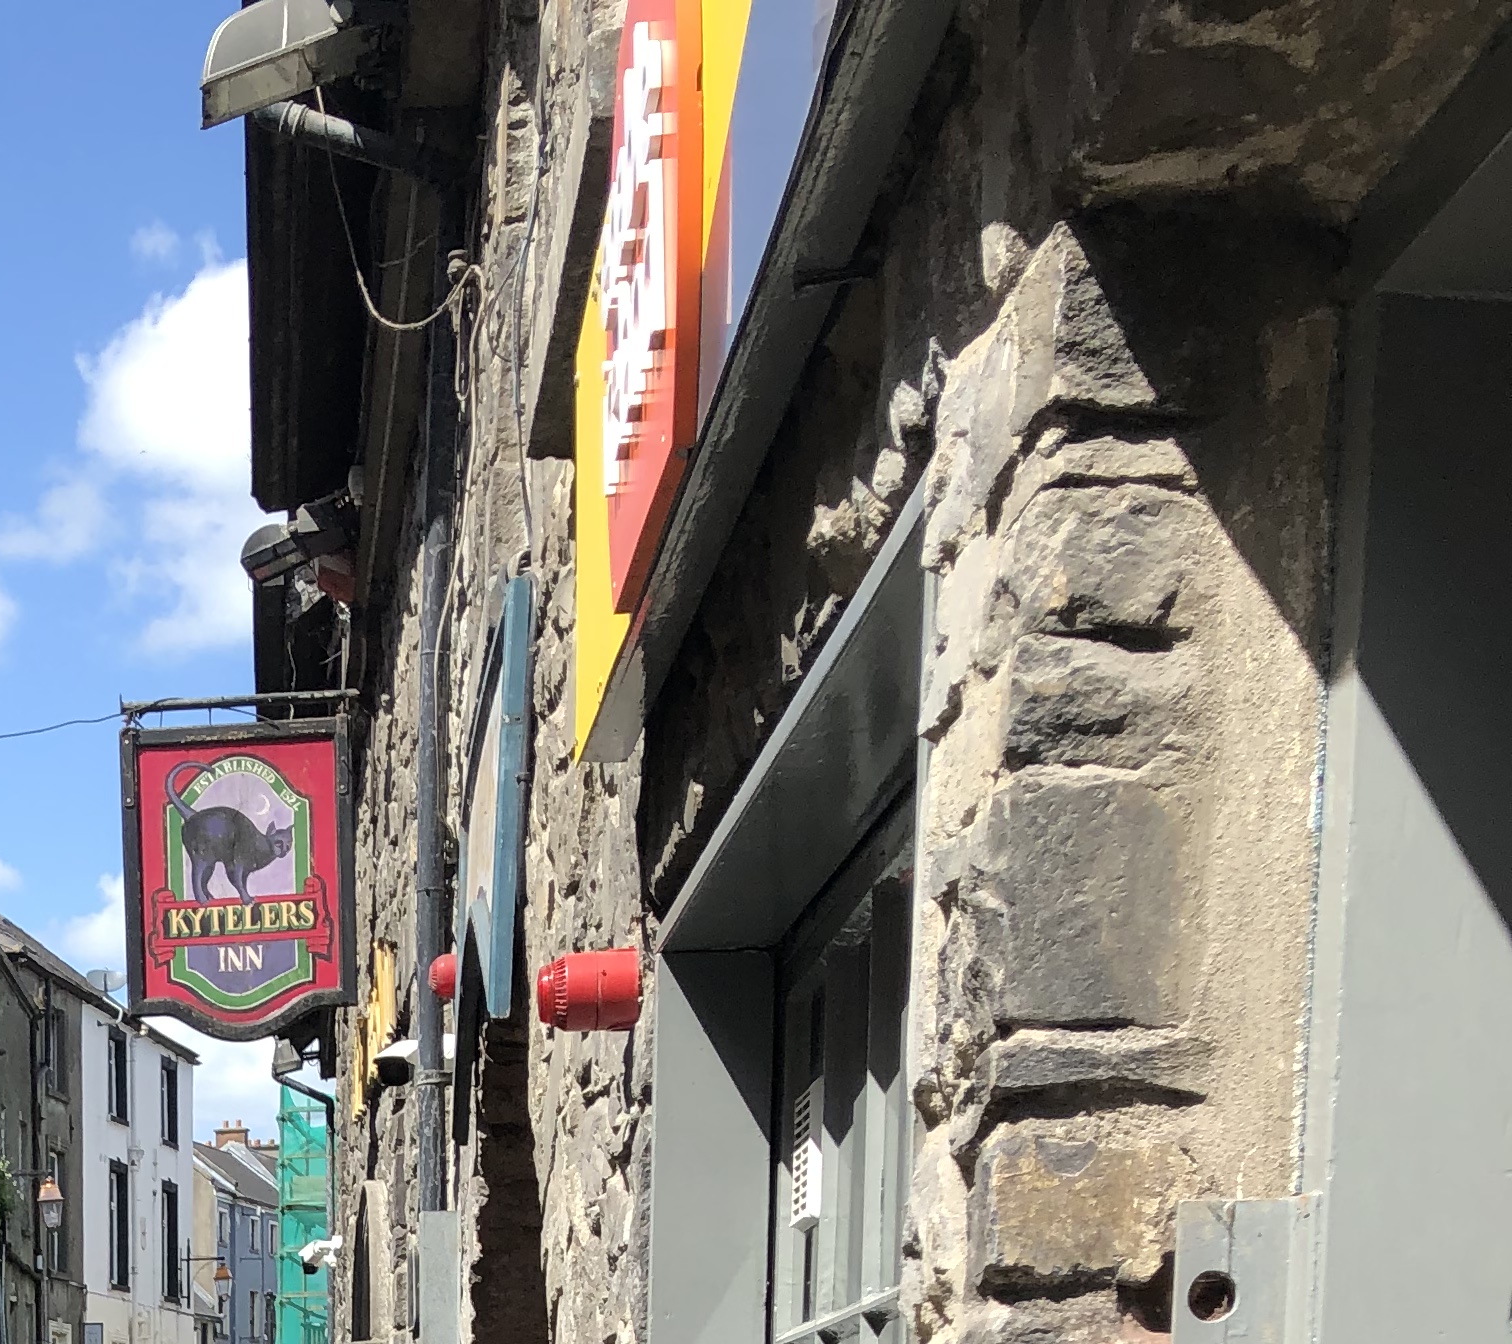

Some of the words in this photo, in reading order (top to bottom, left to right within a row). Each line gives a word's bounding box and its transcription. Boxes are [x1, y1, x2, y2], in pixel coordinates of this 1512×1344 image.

[193, 760, 276, 795] ESTABLISHED
[167, 900, 315, 938] KYTELERS
[216, 945, 264, 972] INN
